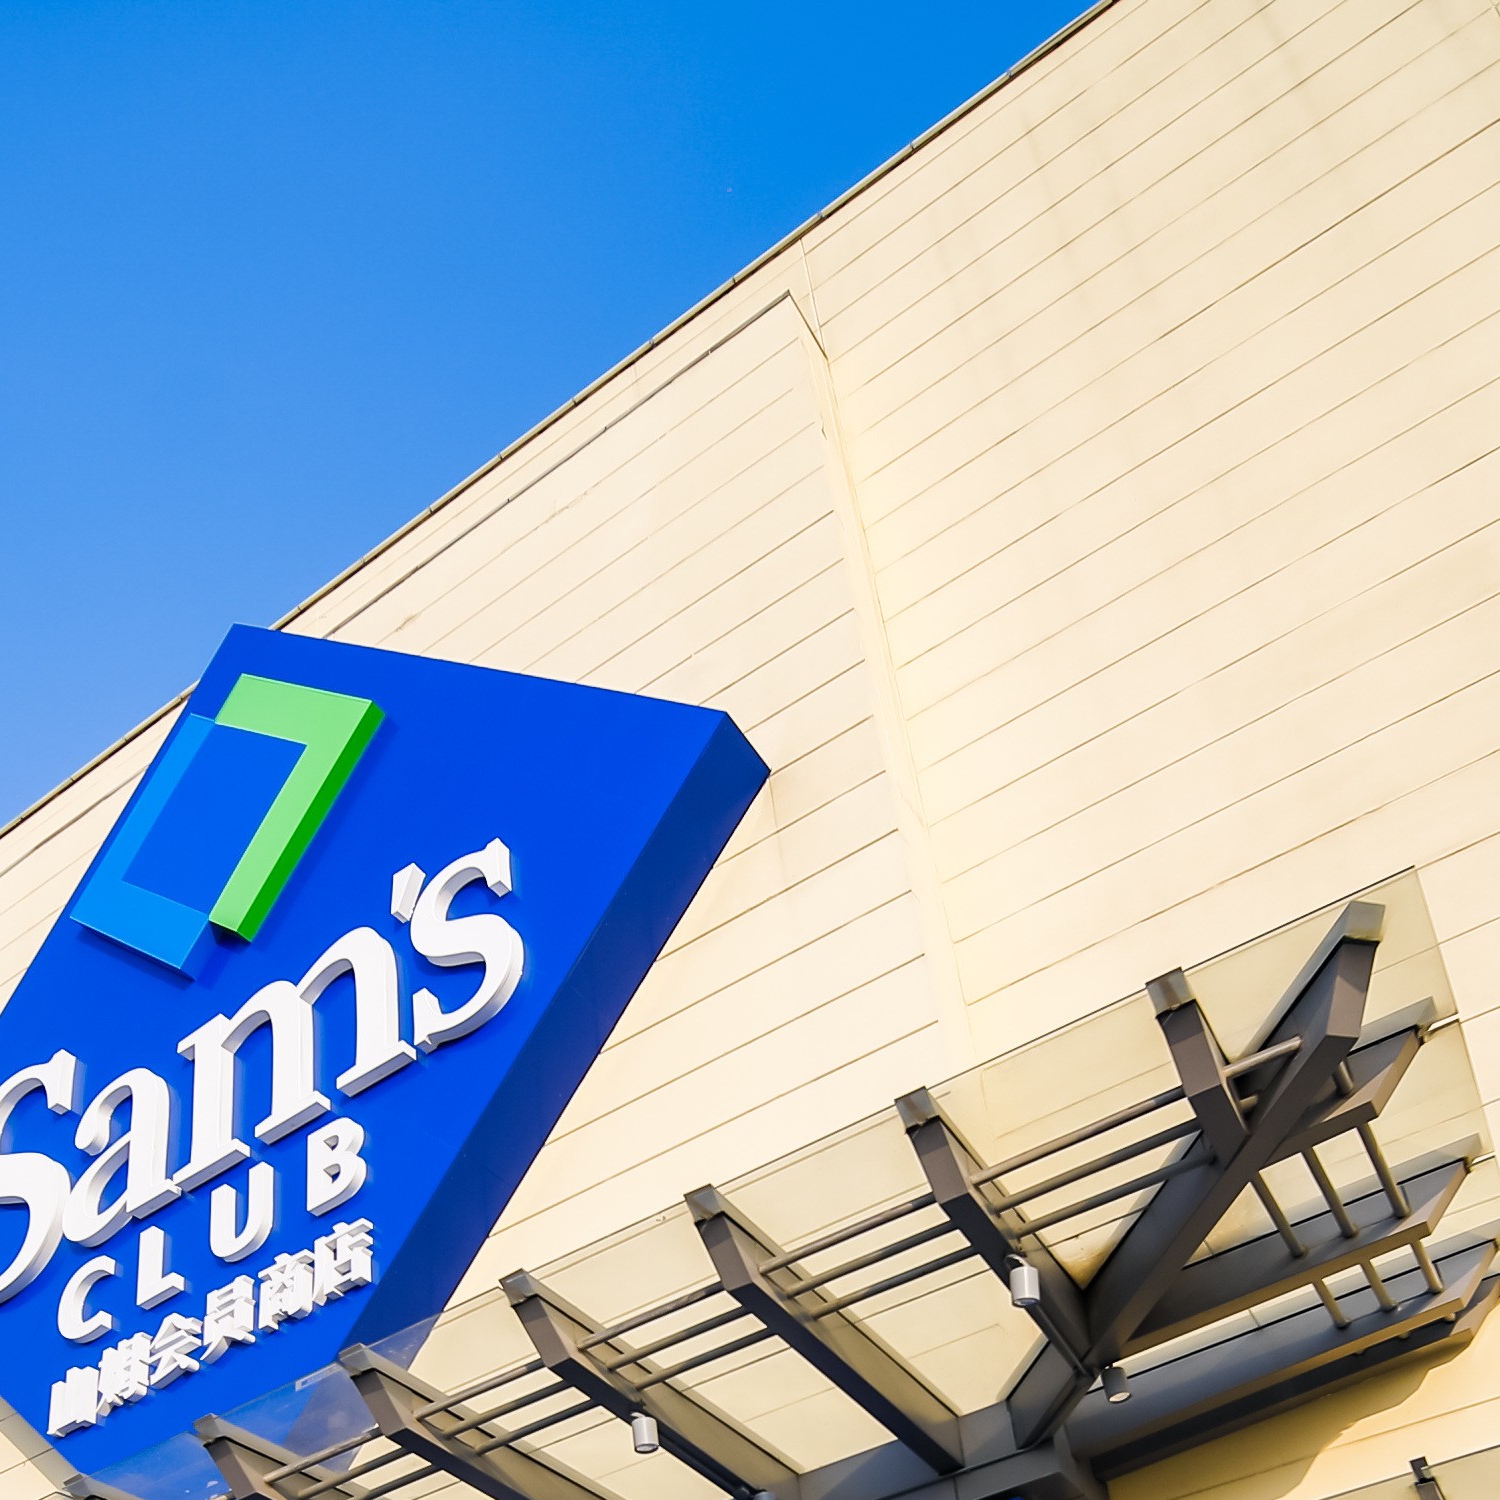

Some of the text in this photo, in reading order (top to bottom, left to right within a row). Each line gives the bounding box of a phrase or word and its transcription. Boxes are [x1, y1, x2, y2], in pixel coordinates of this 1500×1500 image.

[47, 1218, 373, 1437] 山姆会员商店
[58, 1117, 367, 1343] CLUB
